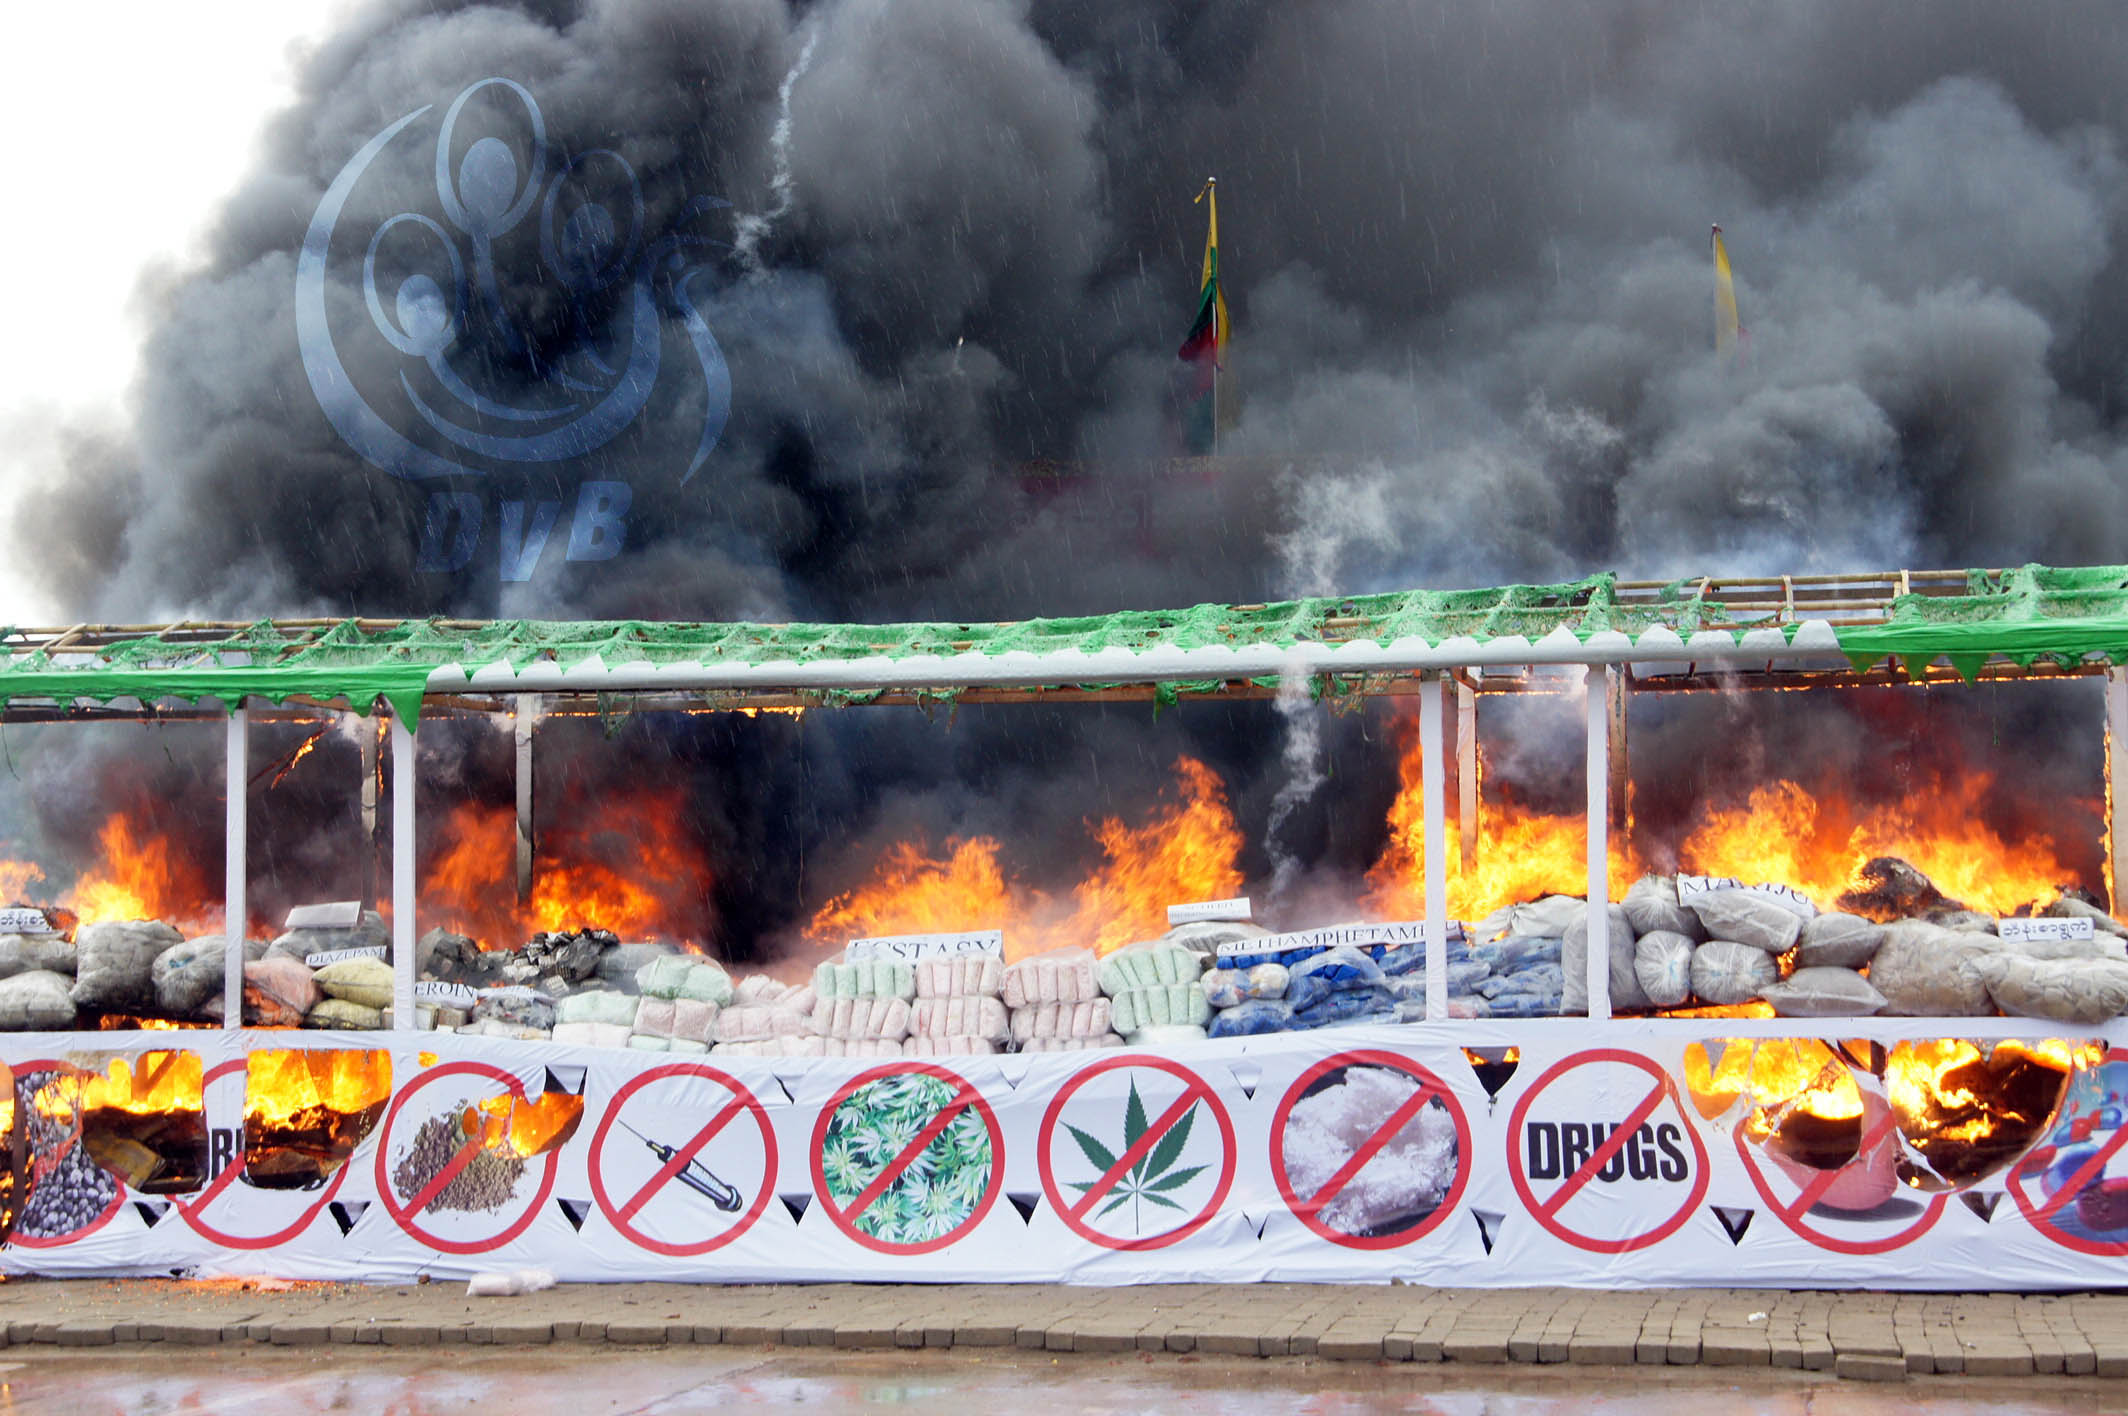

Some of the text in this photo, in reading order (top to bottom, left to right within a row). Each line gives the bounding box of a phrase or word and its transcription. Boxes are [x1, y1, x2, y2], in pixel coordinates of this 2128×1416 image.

[1221, 923, 1457, 951] METHAMPHETAMIE
[415, 983, 475, 998] EROIN
[1528, 1122, 1688, 1183] DRUGS
